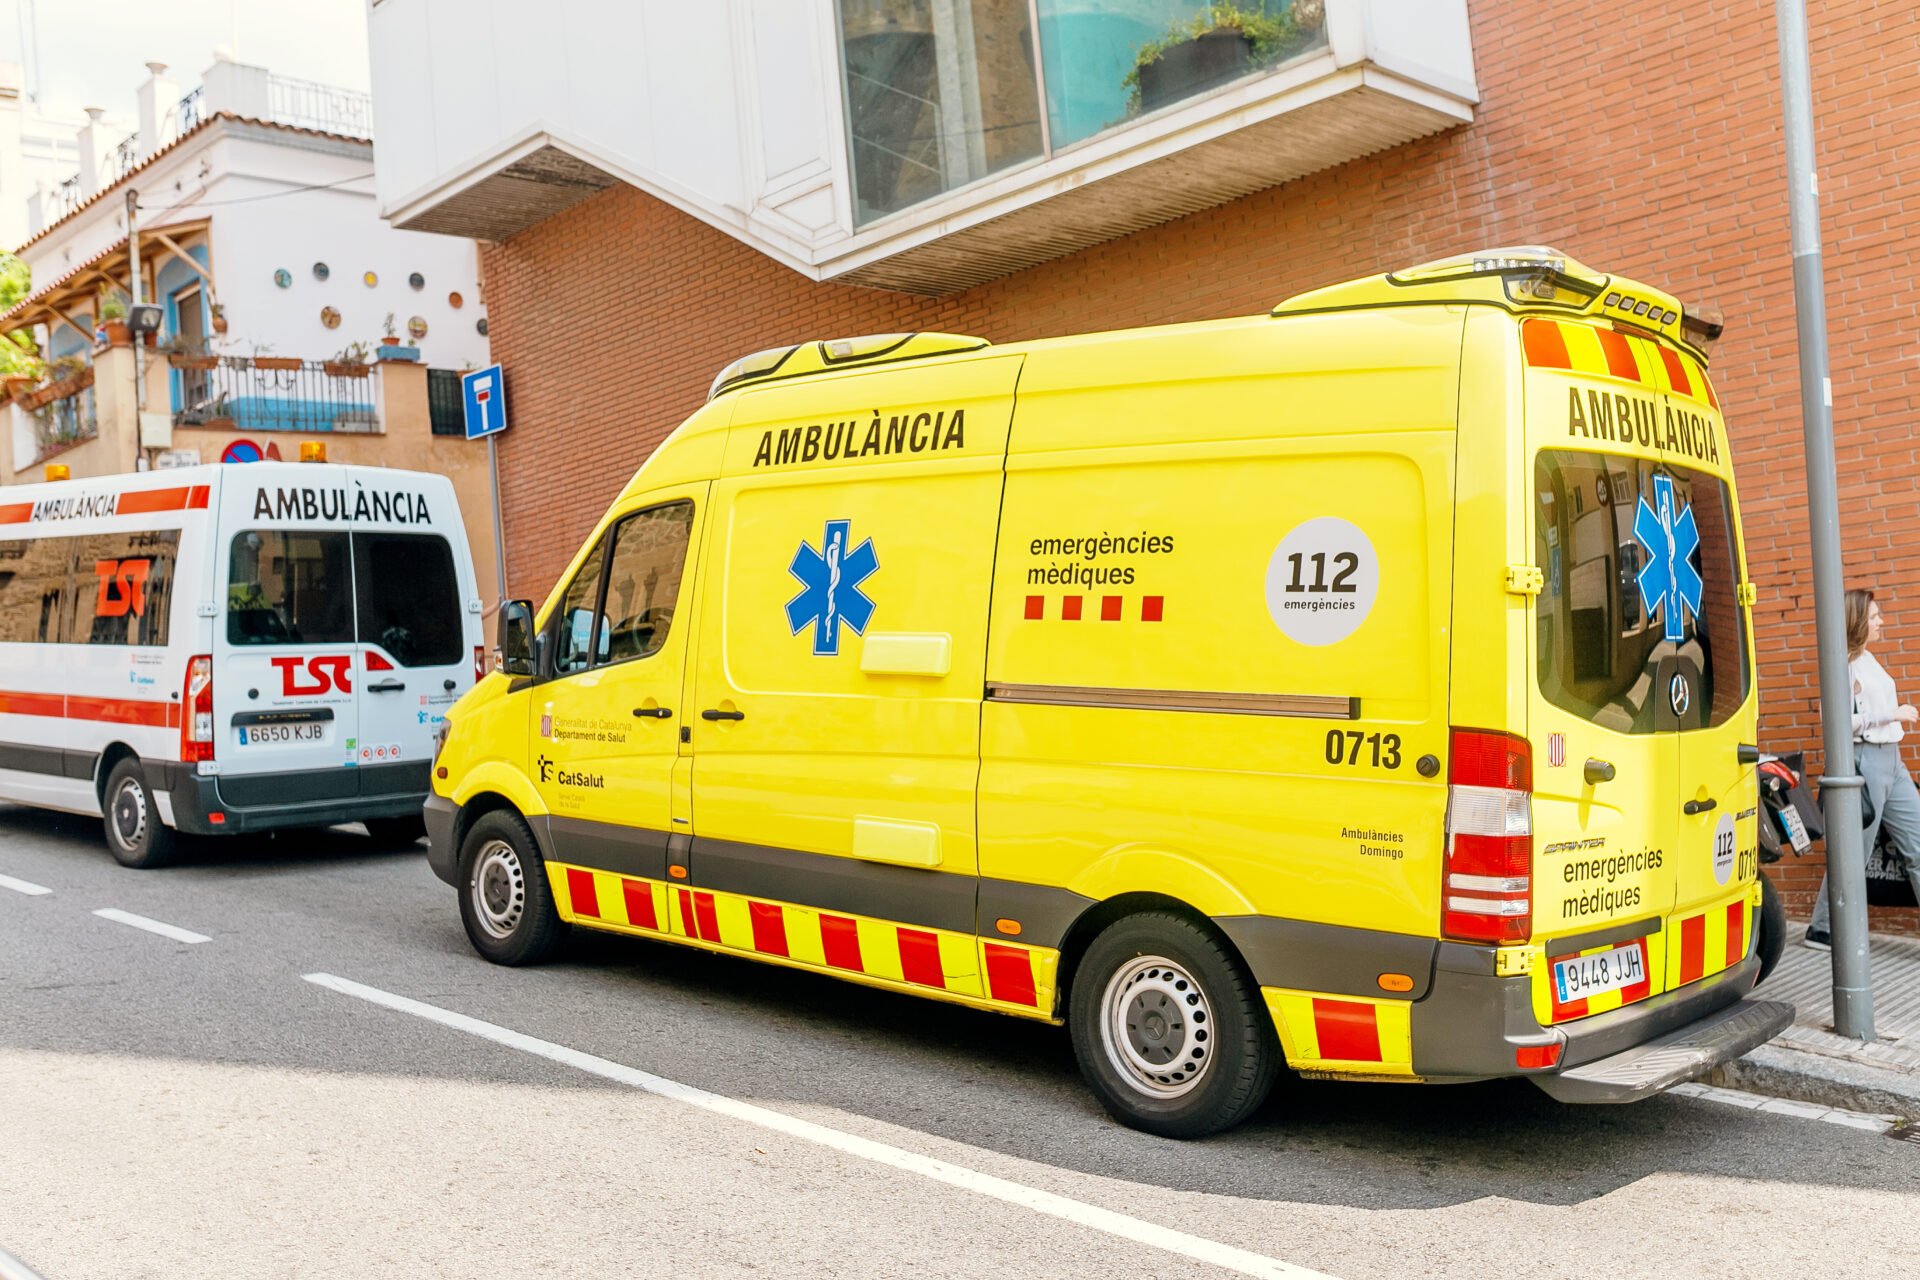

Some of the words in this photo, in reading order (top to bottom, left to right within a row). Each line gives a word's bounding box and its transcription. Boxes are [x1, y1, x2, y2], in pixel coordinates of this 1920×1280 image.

[752, 409, 965, 467] AMBULÀNCIA
[1569, 386, 1719, 465] AMBULÀNCIA
[253, 480, 432, 524] AMBULÀNCIA
[1030, 531, 1174, 560] emergències
[1027, 561, 1135, 590] mèdiques
[1284, 551, 1360, 594] 112
[1283, 597, 1356, 612] emergències
[250, 726, 290, 742] 6650
[294, 724, 323, 740] KJB
[554, 728, 596, 741] Departament
[597, 732, 606, 742] de
[607, 732, 626, 743] Salut
[1324, 729, 1402, 770] 0713
[558, 771, 605, 788] CatSalut
[1341, 827, 1404, 843] Ambulàncies
[1717, 831, 1733, 857] 112
[1360, 844, 1404, 860] Domingo
[1563, 845, 1663, 883] emergències
[1738, 846, 1756, 881] 0713
[1563, 886, 1641, 918] mèdiques
[1568, 958, 1610, 992] 9448
[1615, 949, 1642, 980] JJH
